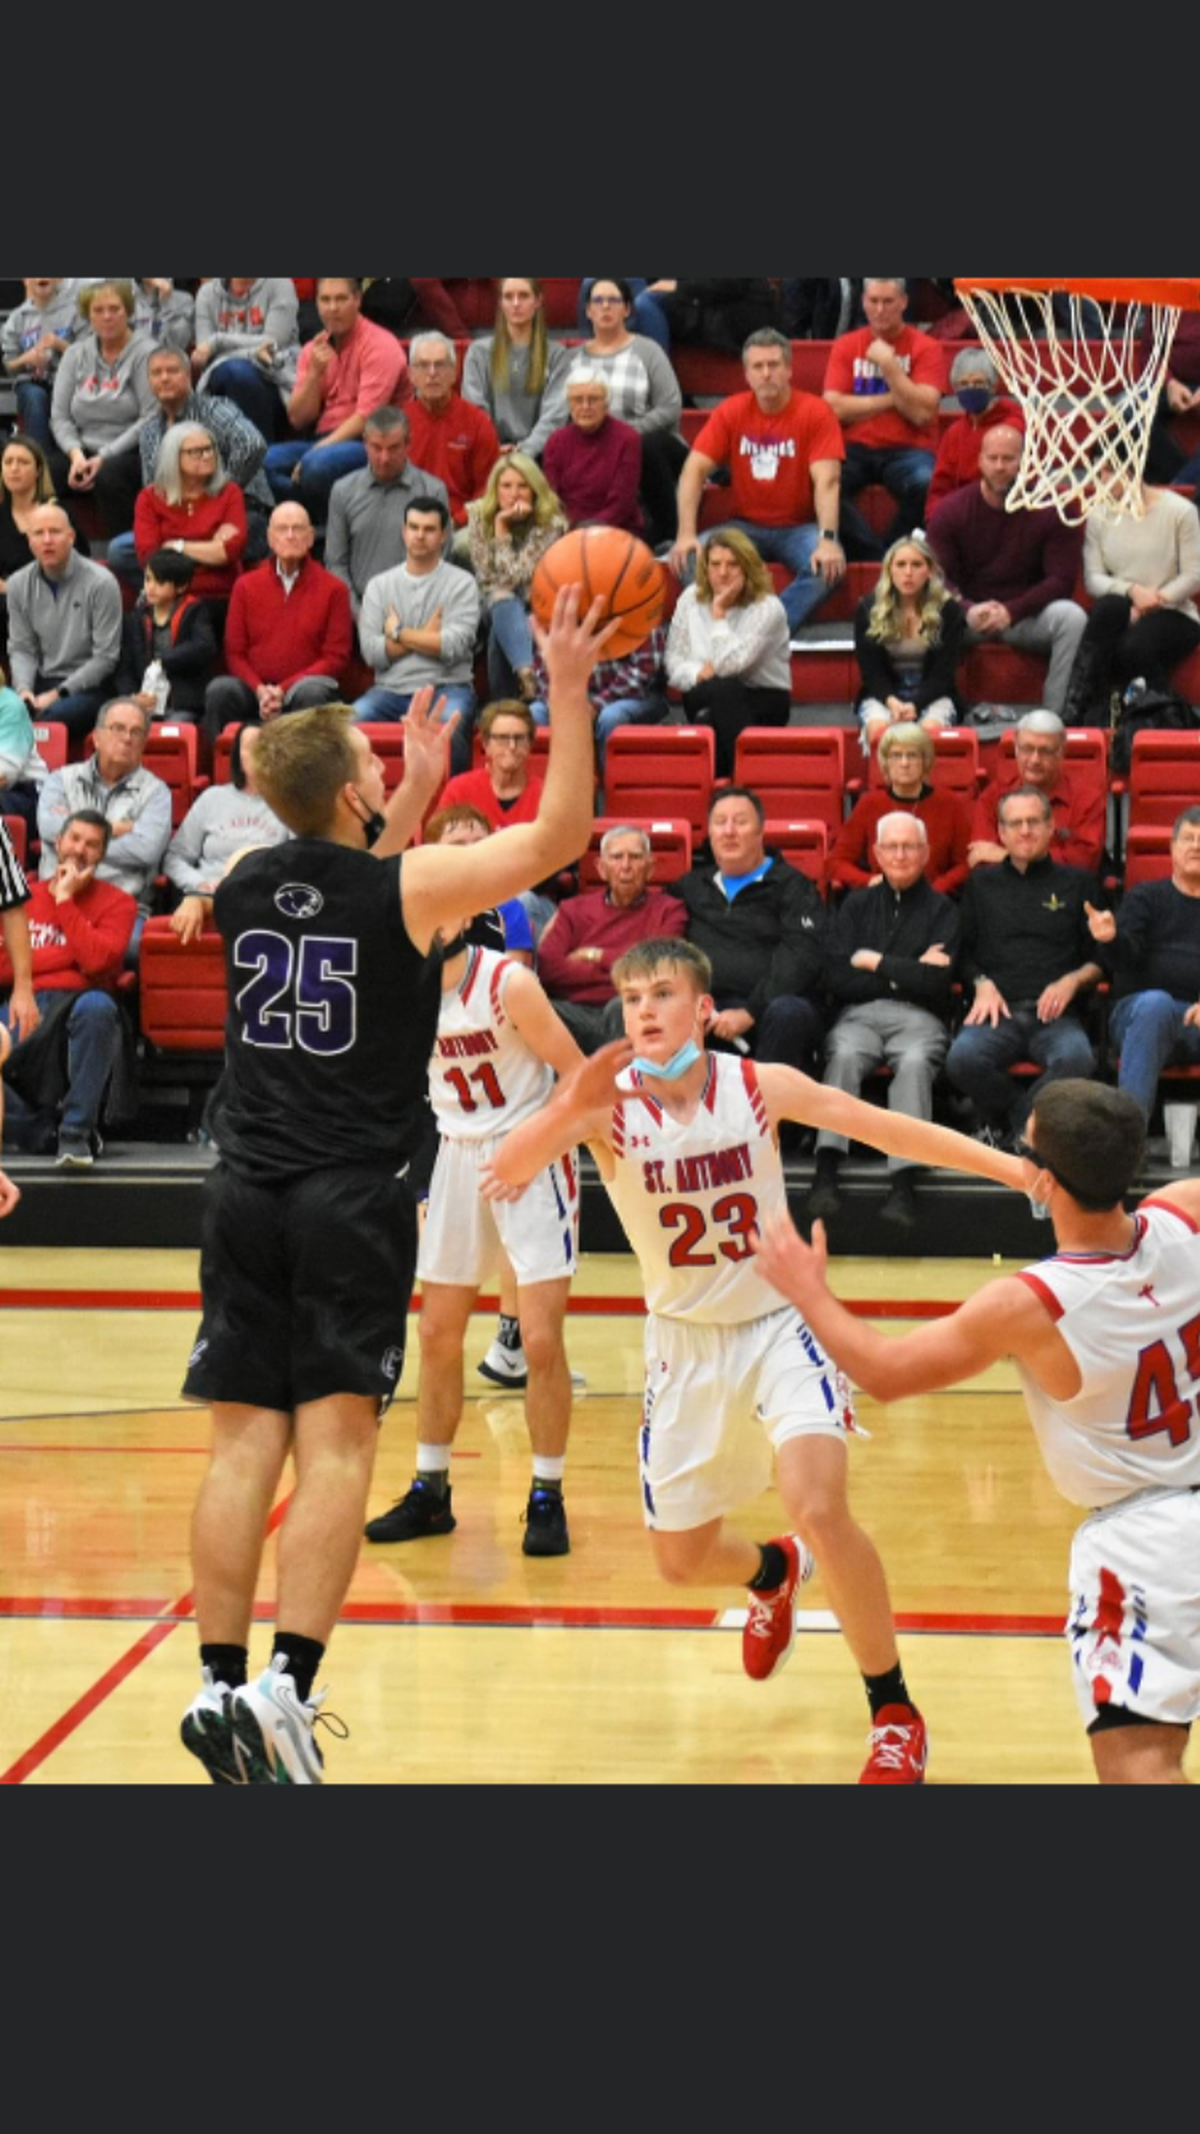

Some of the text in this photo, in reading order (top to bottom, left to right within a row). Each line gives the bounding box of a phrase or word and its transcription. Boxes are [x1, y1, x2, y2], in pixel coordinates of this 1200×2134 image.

[234, 929, 358, 1057] 25
[443, 1061, 506, 1113] 11
[643, 1142, 753, 1194] ST. ANTHONY
[659, 1192, 760, 1268] 23
